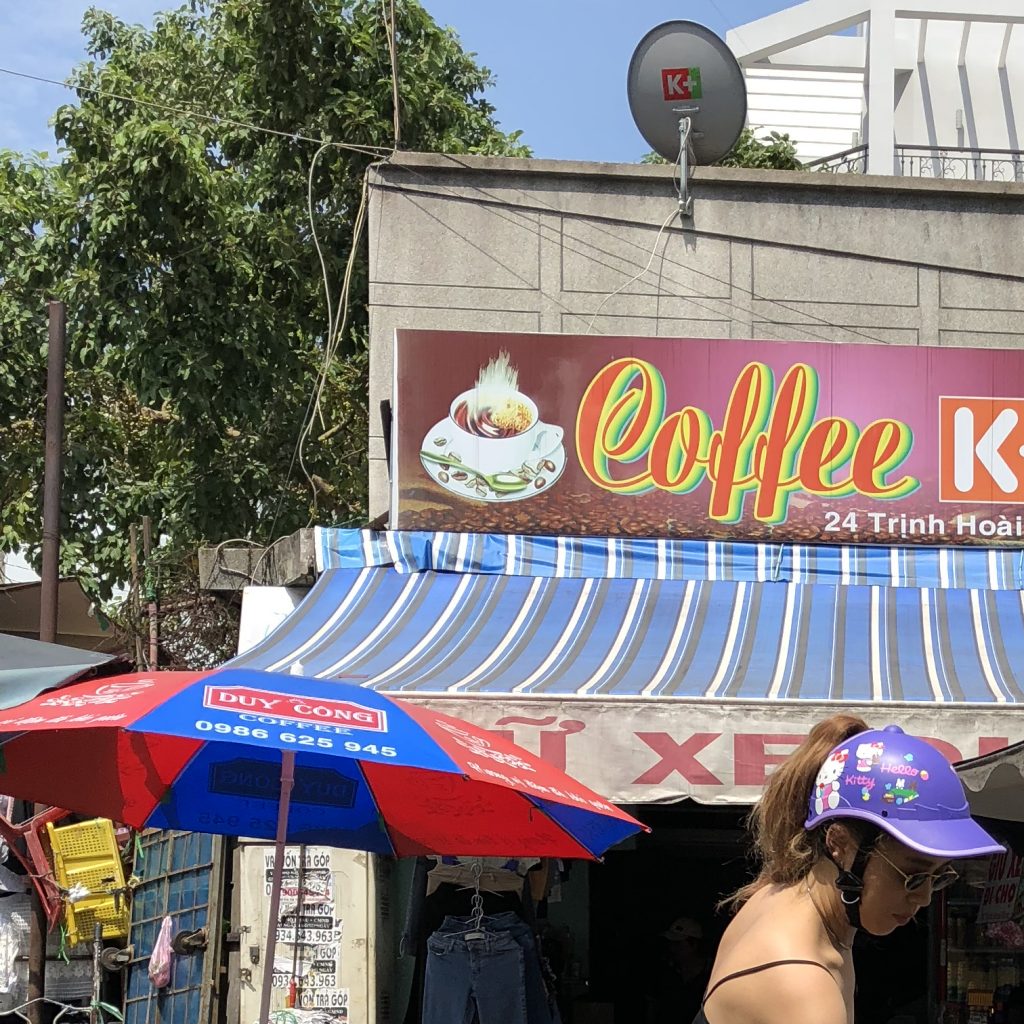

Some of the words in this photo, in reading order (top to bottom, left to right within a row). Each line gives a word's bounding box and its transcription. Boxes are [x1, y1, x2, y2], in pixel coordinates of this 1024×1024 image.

[576, 357, 922, 525] Coffee
[824, 511, 858, 533] 24
[868, 512, 945, 538] Trịnh
[957, 514, 1021, 536] Hoài
[218, 691, 281, 709] DUY
[293, 703, 374, 723] CÔNG
[239, 713, 353, 736] COFFEE
[195, 720, 268, 739] 0986
[279, 733, 333, 748] 625
[344, 742, 397, 757] 945
[845, 774, 876, 790] Kitty
[880, 762, 919, 777] Hello
